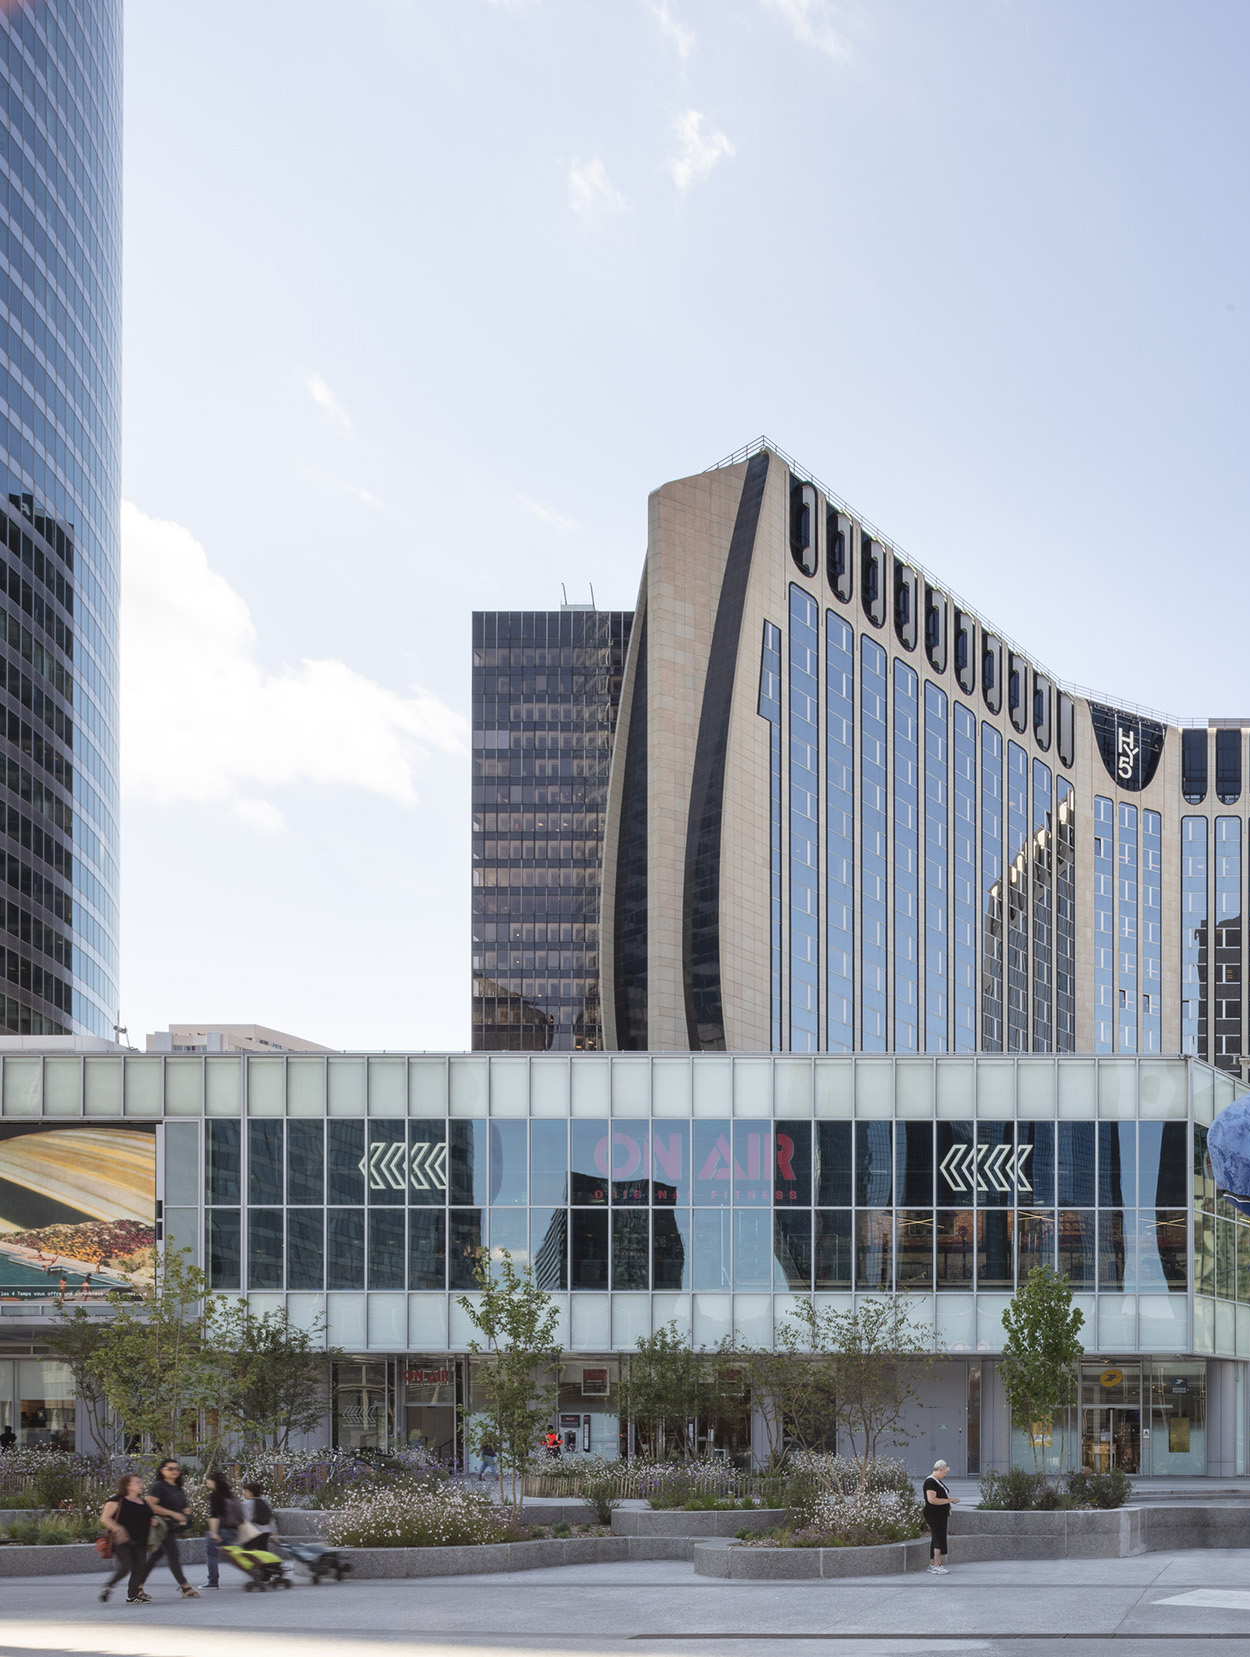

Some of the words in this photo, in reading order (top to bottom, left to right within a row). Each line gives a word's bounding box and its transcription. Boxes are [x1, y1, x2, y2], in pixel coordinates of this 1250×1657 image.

[594, 1132, 682, 1180] ON
[696, 1132, 797, 1181] AIR
[711, 1189, 797, 1200] FITNESS
[17, 1290, 32, 1298] Temps
[403, 1369, 424, 1381] ON
[427, 1369, 449, 1381] AIR
